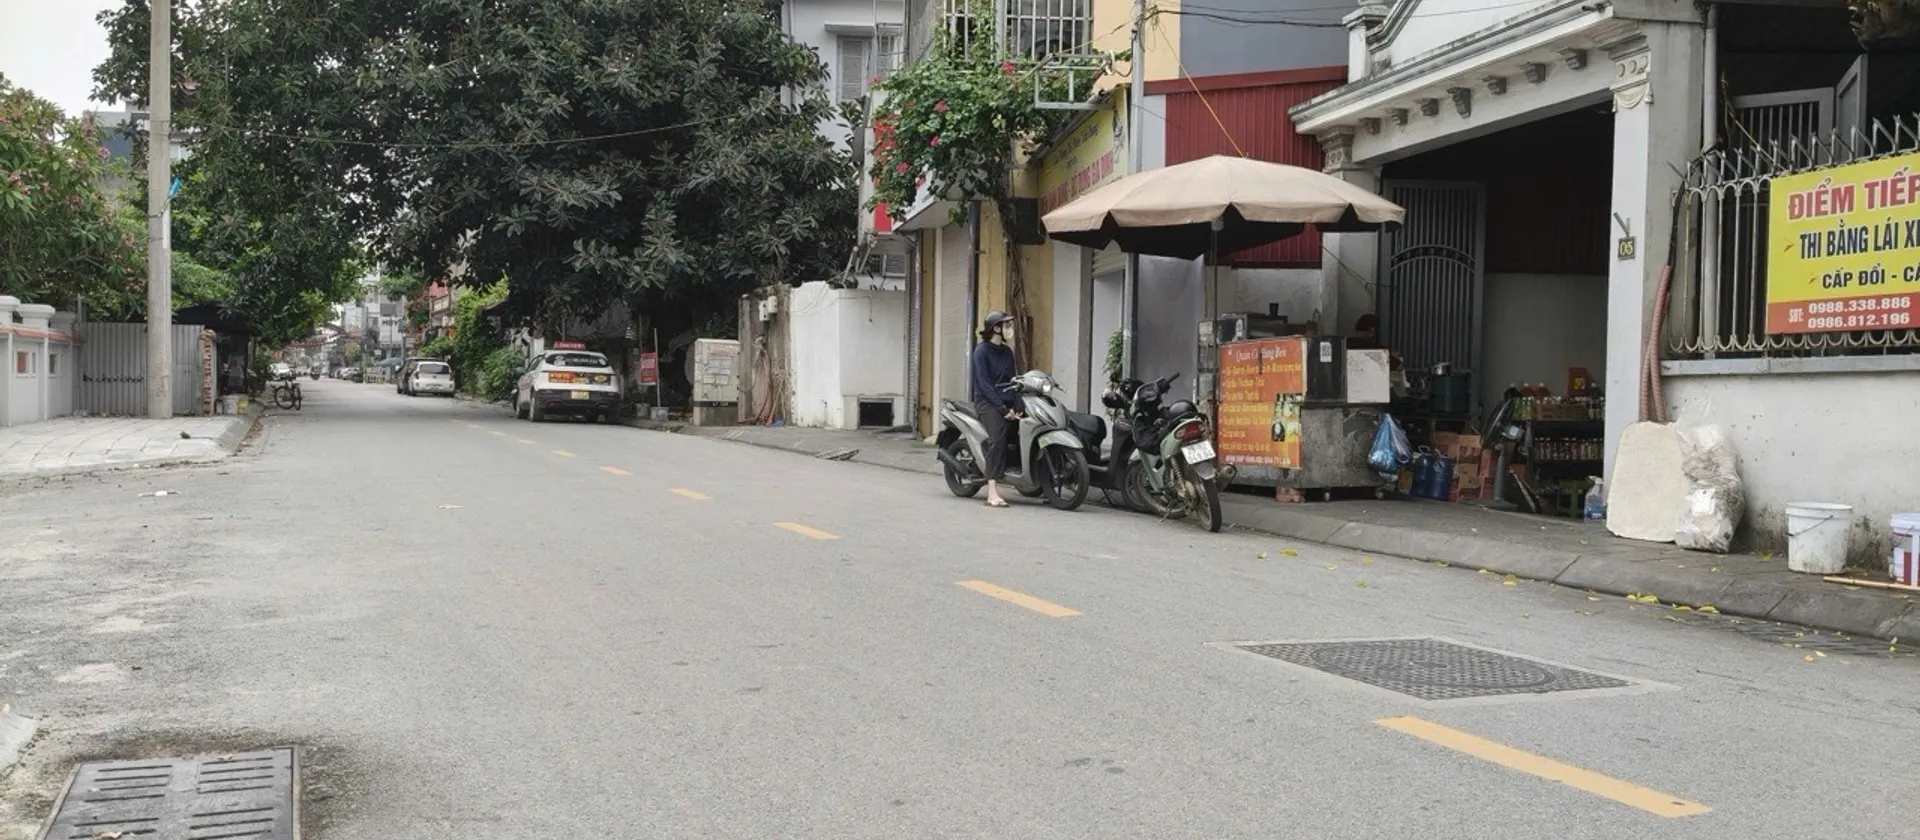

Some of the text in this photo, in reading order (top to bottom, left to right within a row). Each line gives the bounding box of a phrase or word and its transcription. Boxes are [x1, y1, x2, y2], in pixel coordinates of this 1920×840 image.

[1788, 166, 1920, 220] ĐIỂM TIẾP
[1620, 240, 1634, 256] 05
[1800, 231, 1822, 259] THI
[1827, 218, 1869, 256] BẰNG
[1874, 216, 1899, 251] LÁI
[1822, 266, 1854, 289] CẤP
[1858, 262, 1886, 287] ĐỔI
[1808, 296, 1911, 314] 0988.338.886
[1807, 312, 1911, 329] 0986.812.196
